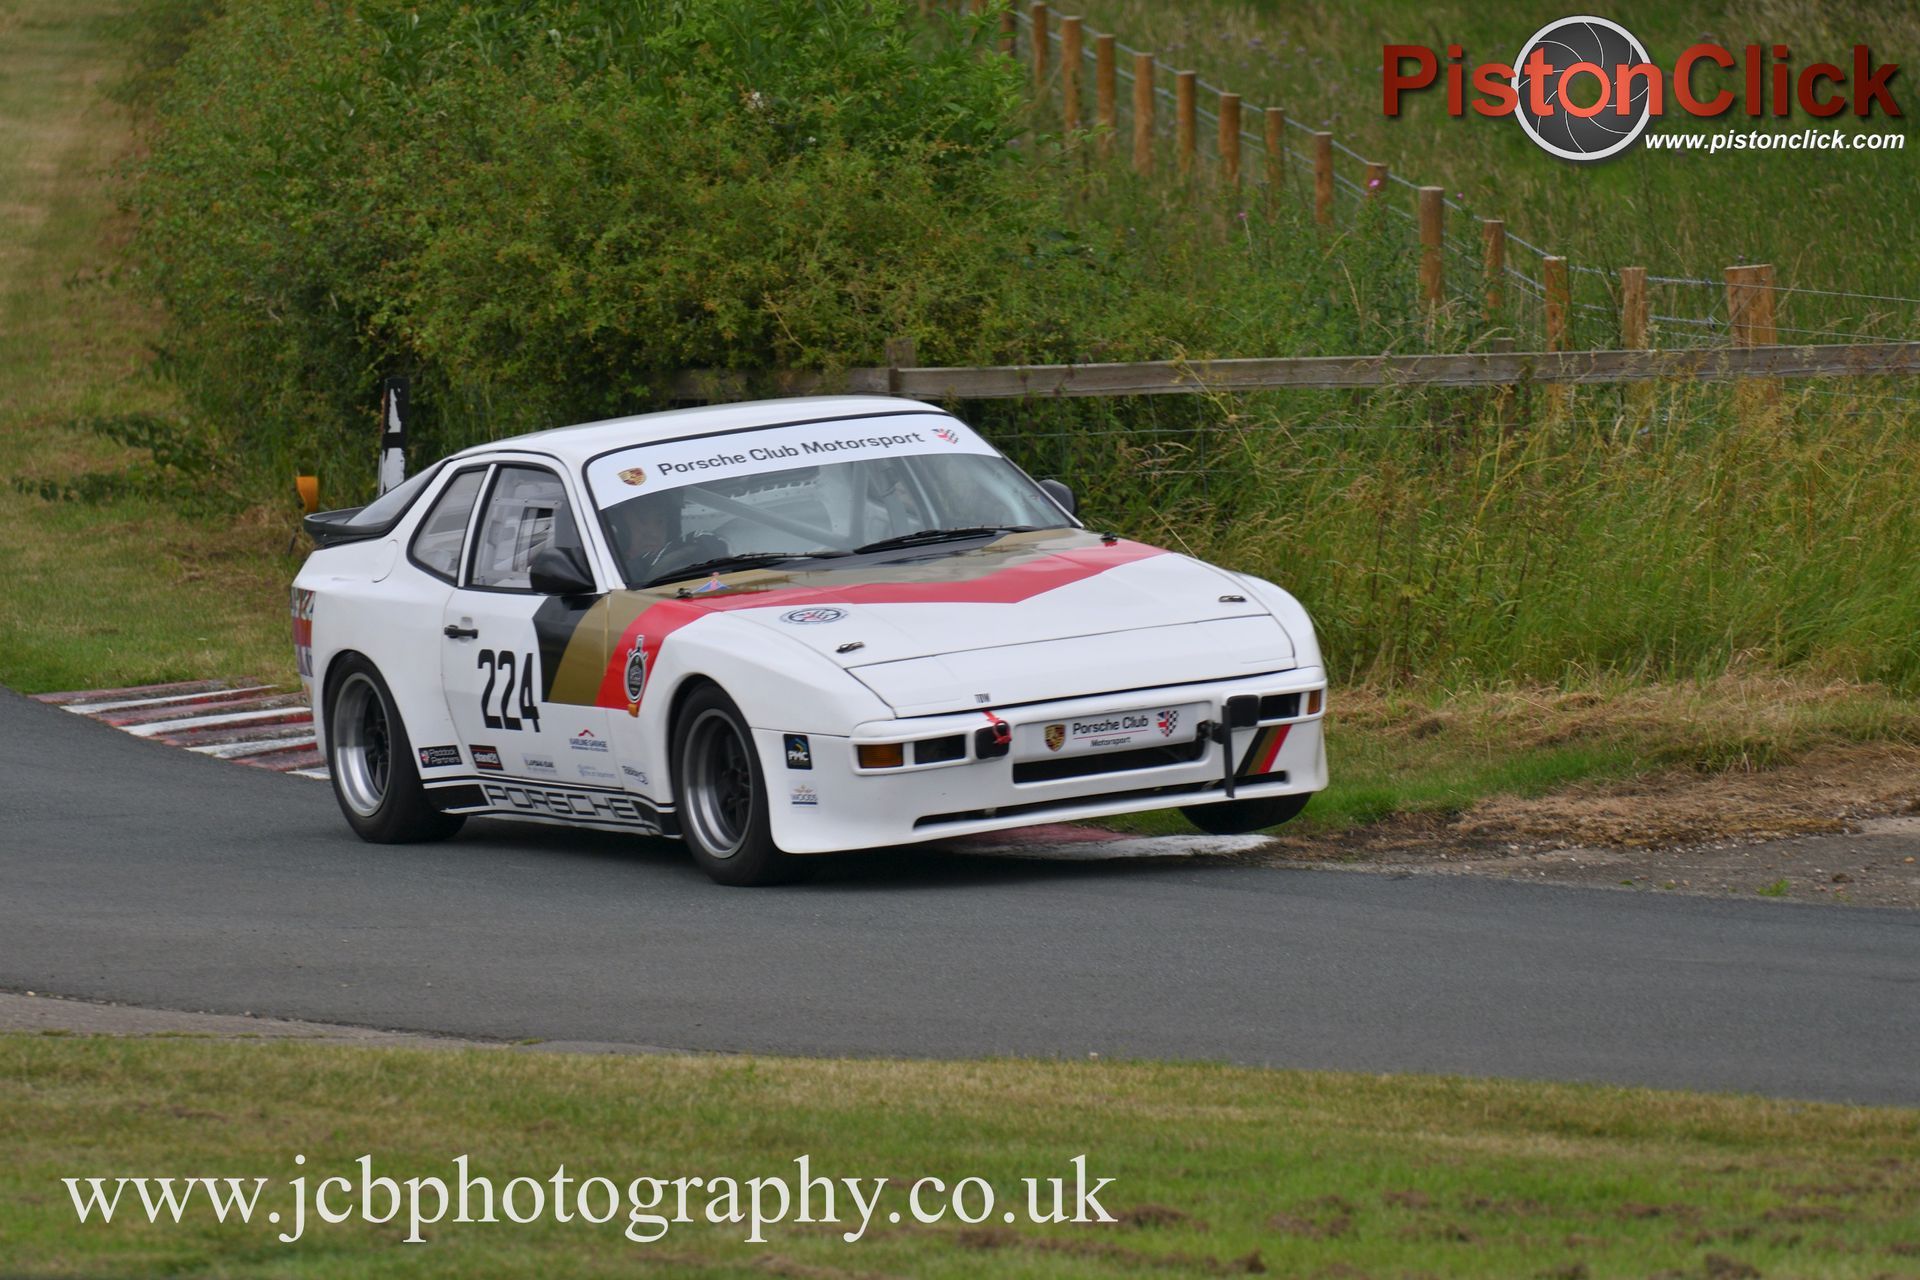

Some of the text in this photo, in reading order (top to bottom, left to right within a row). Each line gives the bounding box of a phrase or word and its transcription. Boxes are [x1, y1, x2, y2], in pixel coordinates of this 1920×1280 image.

[657, 431, 925, 476] Porsche Club Motorsport
[477, 649, 541, 732] 224
[1073, 715, 1149, 735] Porsche Club
[1090, 736, 1131, 748] Motorsport
[483, 784, 641, 820] PORSCHE
